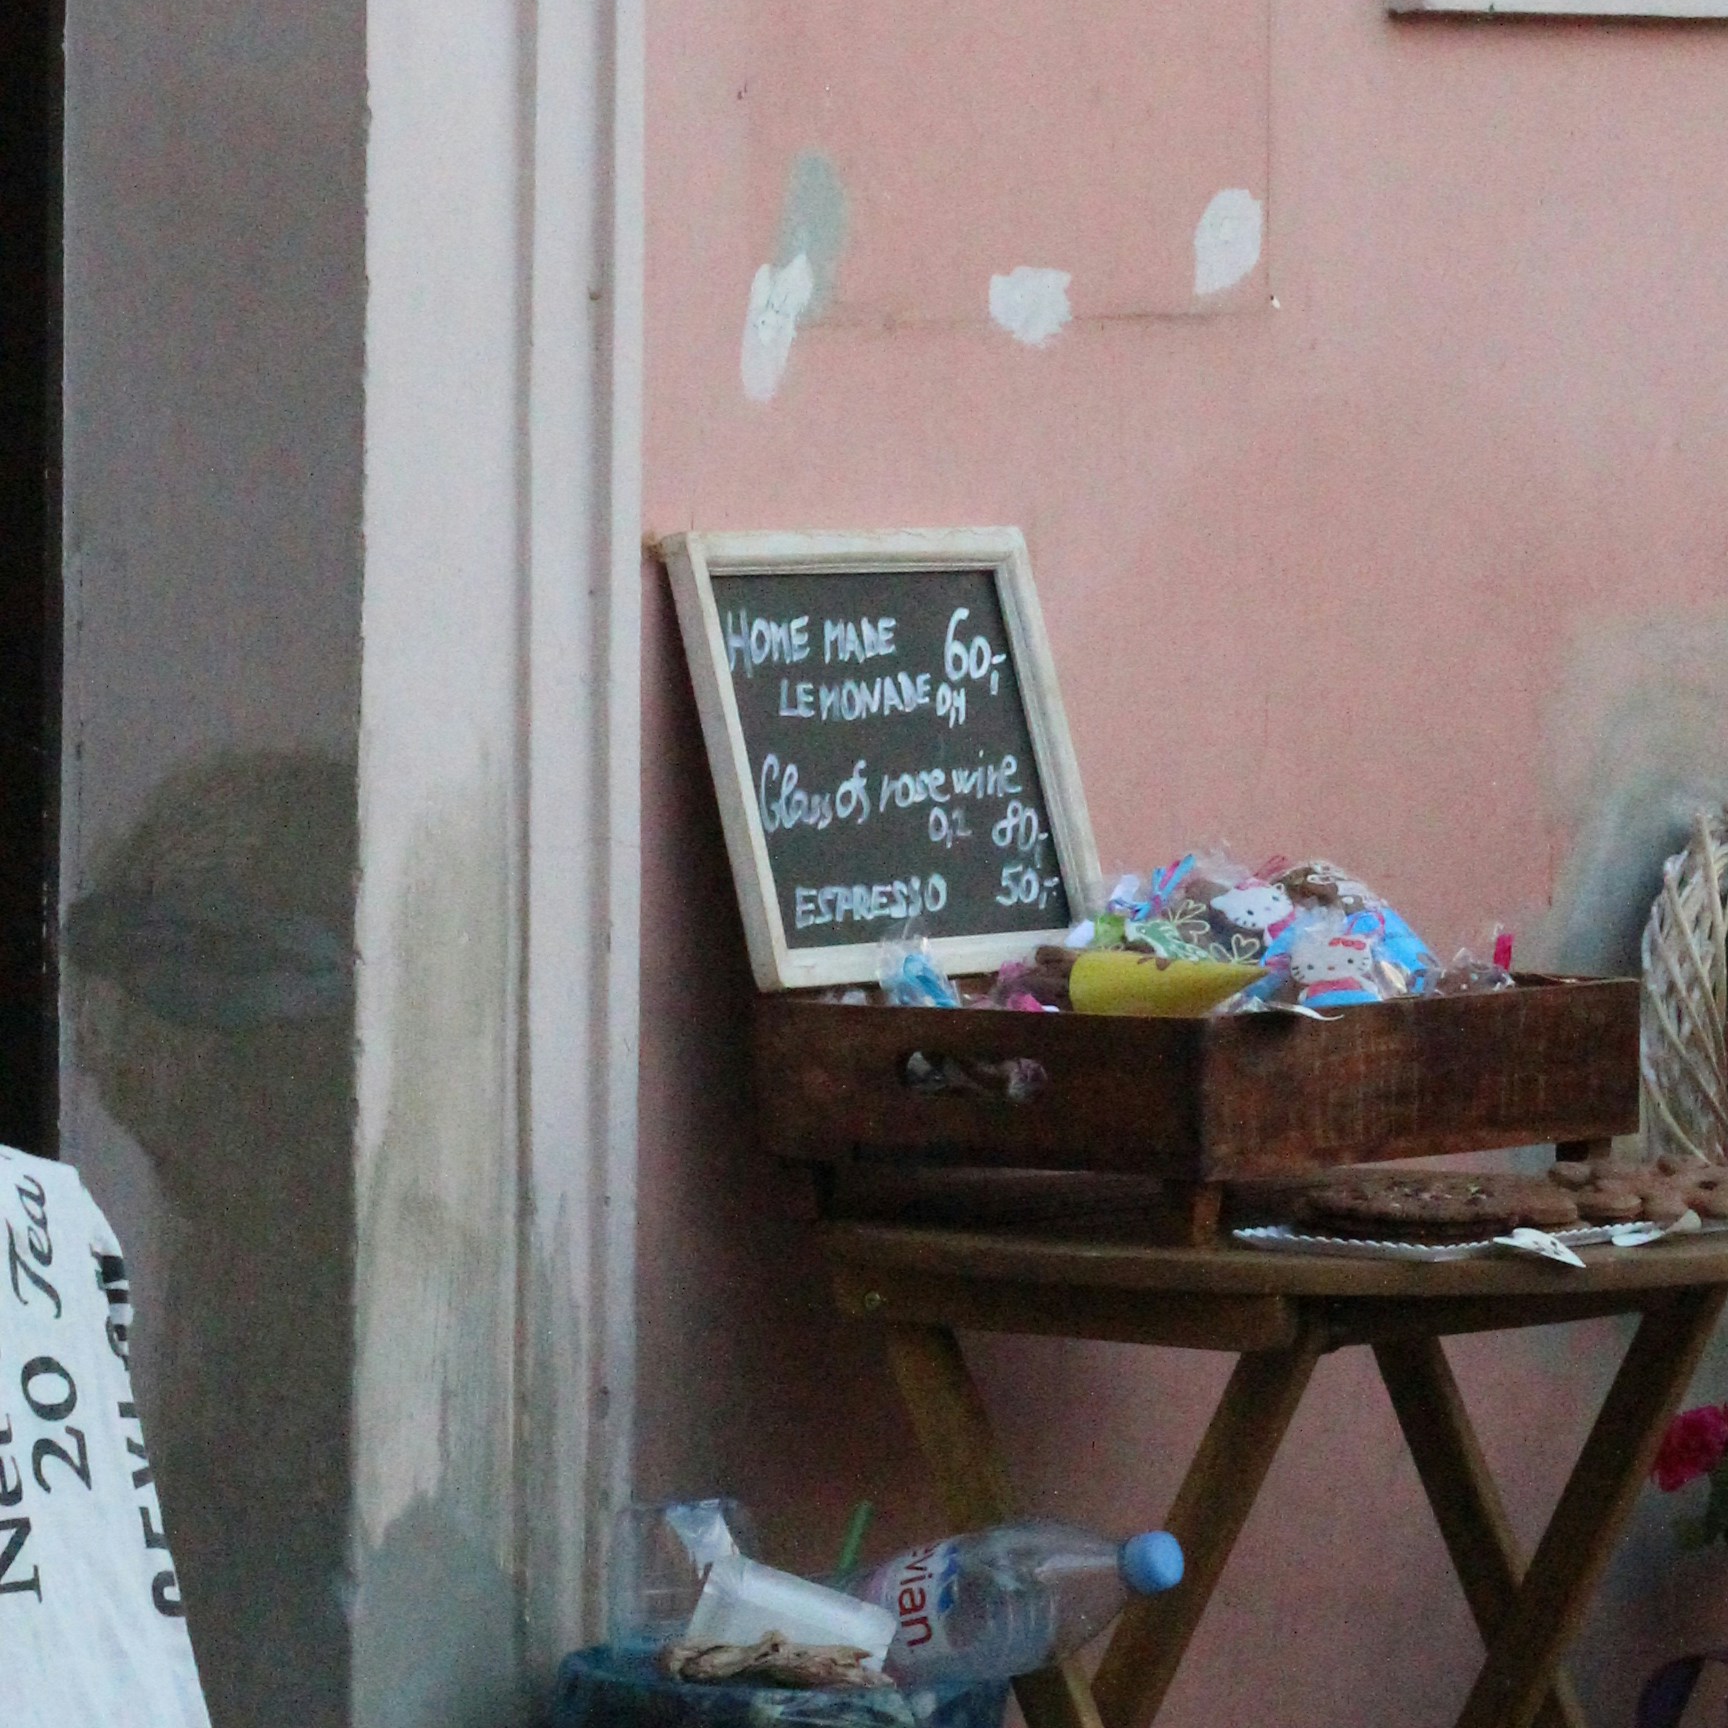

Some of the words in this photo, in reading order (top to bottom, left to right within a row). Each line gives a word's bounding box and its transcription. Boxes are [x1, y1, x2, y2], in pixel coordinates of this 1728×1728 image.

[726, 606, 810, 678] HOME
[824, 616, 897, 664] MADE
[779, 670, 931, 722] LEMONADE
[760, 752, 833, 833] Glass
[836, 758, 870, 825] of
[879, 766, 951, 813] rose
[951, 748, 1022, 799] wine
[794, 872, 948, 929] ESPRESSO
[5, 1174, 62, 1319] Tea
[21, 1355, 92, 1494] 20
